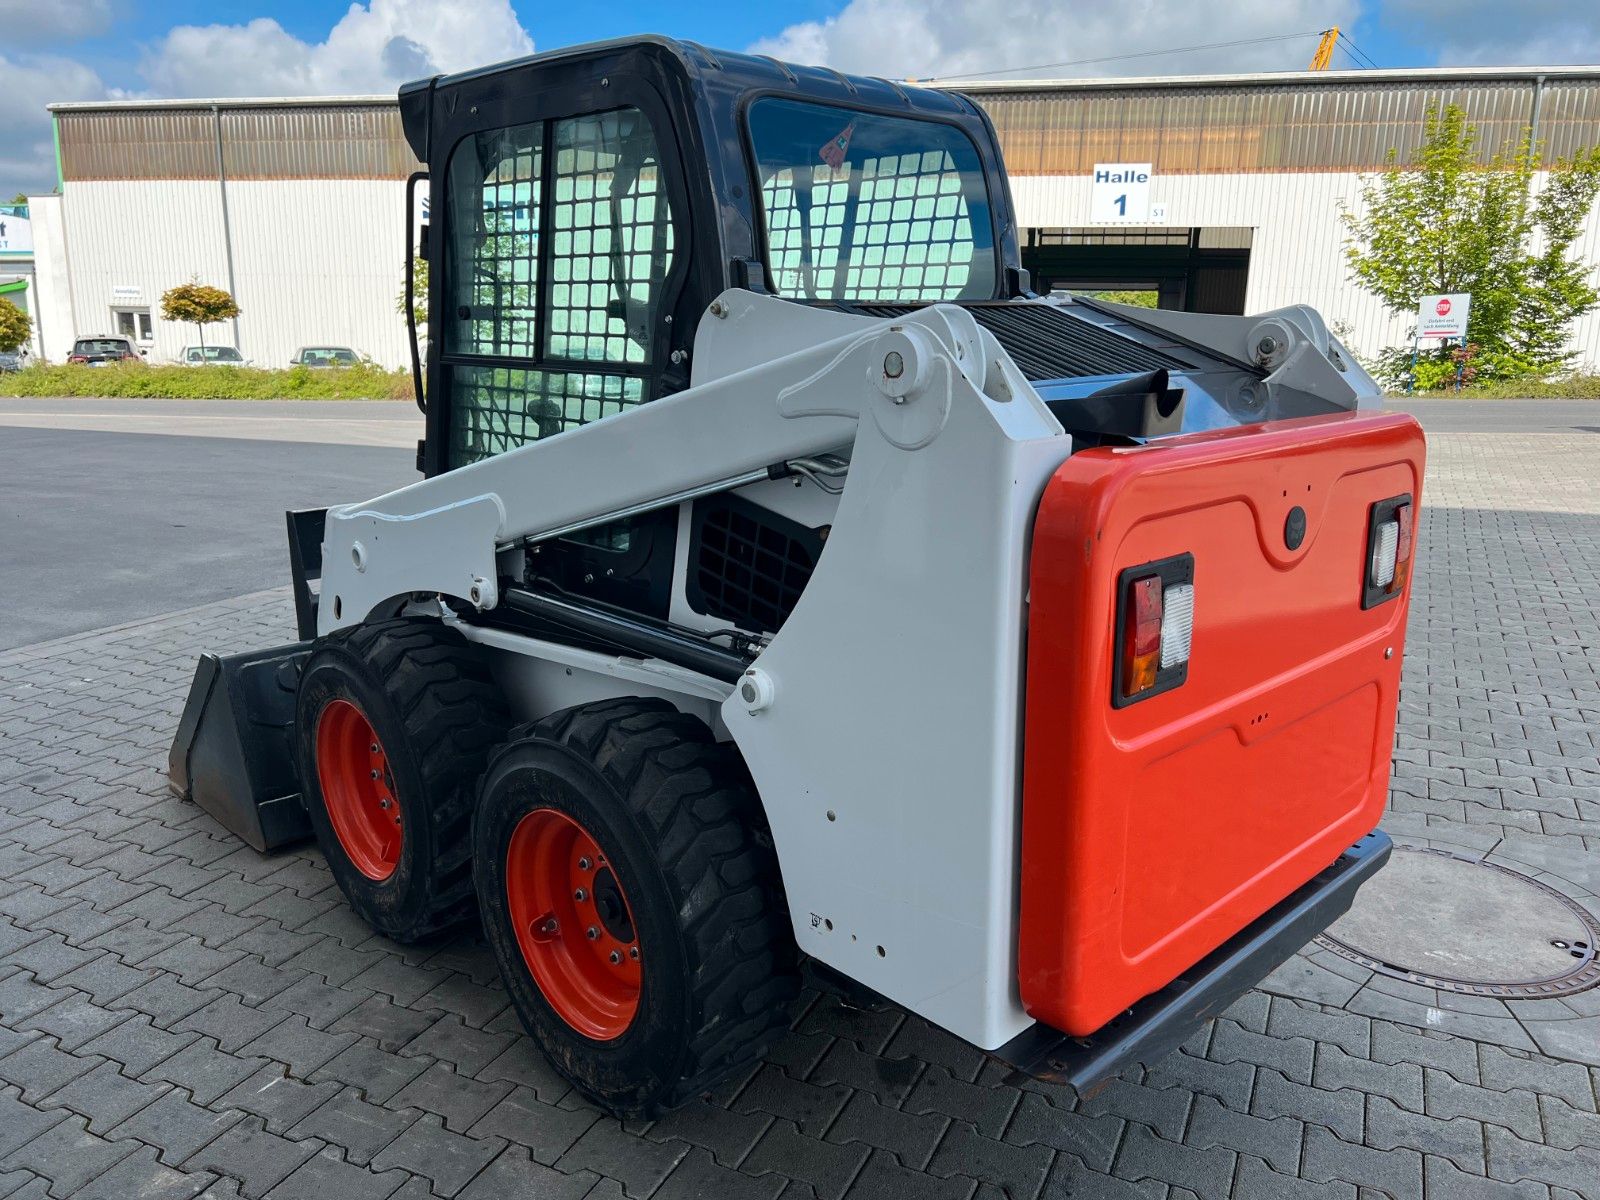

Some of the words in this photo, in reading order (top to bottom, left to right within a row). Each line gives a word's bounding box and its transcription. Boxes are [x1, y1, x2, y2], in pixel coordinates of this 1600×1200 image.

[1095, 170, 1148, 183] Halle
[1113, 194, 1127, 216] 1
[1437, 303, 1450, 311] STOP
